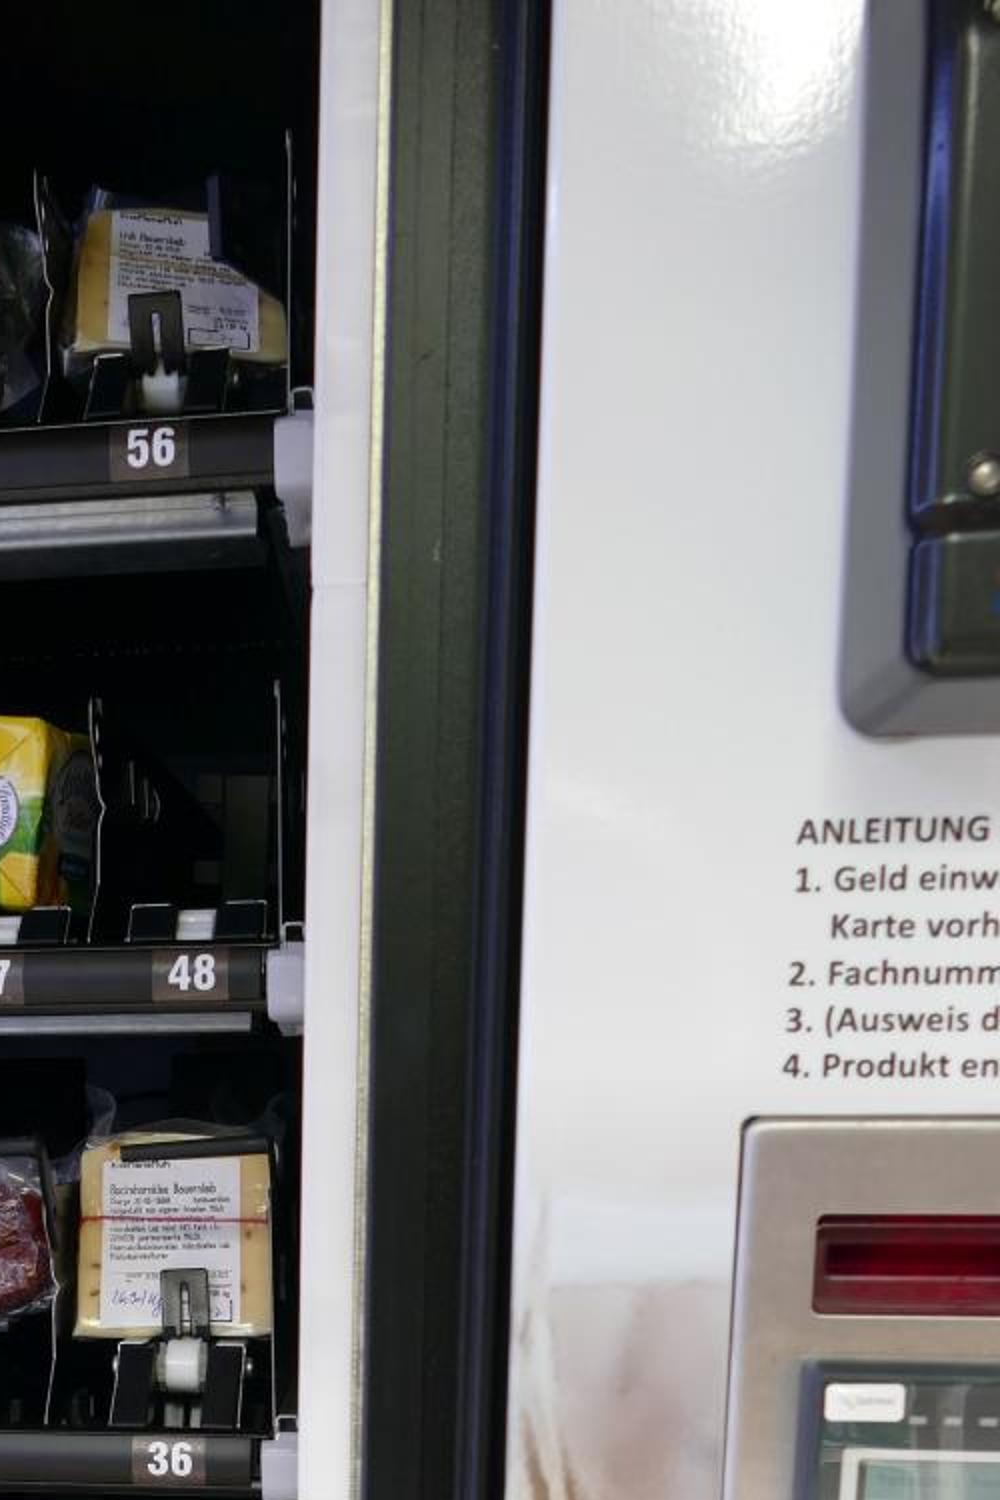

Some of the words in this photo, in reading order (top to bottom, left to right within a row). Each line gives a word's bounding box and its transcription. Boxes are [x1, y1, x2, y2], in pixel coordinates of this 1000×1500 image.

[128, 428, 170, 468] 56
[796, 815, 990, 845] ANLEITUNG
[796, 867, 821, 893] 1.
[834, 864, 908, 892] Geld
[831, 914, 915, 939] Karte
[168, 954, 215, 990] 48
[788, 961, 815, 987] 2.
[786, 1008, 812, 1033] 3.
[825, 1005, 970, 1039] (Ausweis
[783, 1053, 809, 1078] 4.
[823, 1052, 950, 1078] Produkt
[147, 1441, 192, 1476] 36
